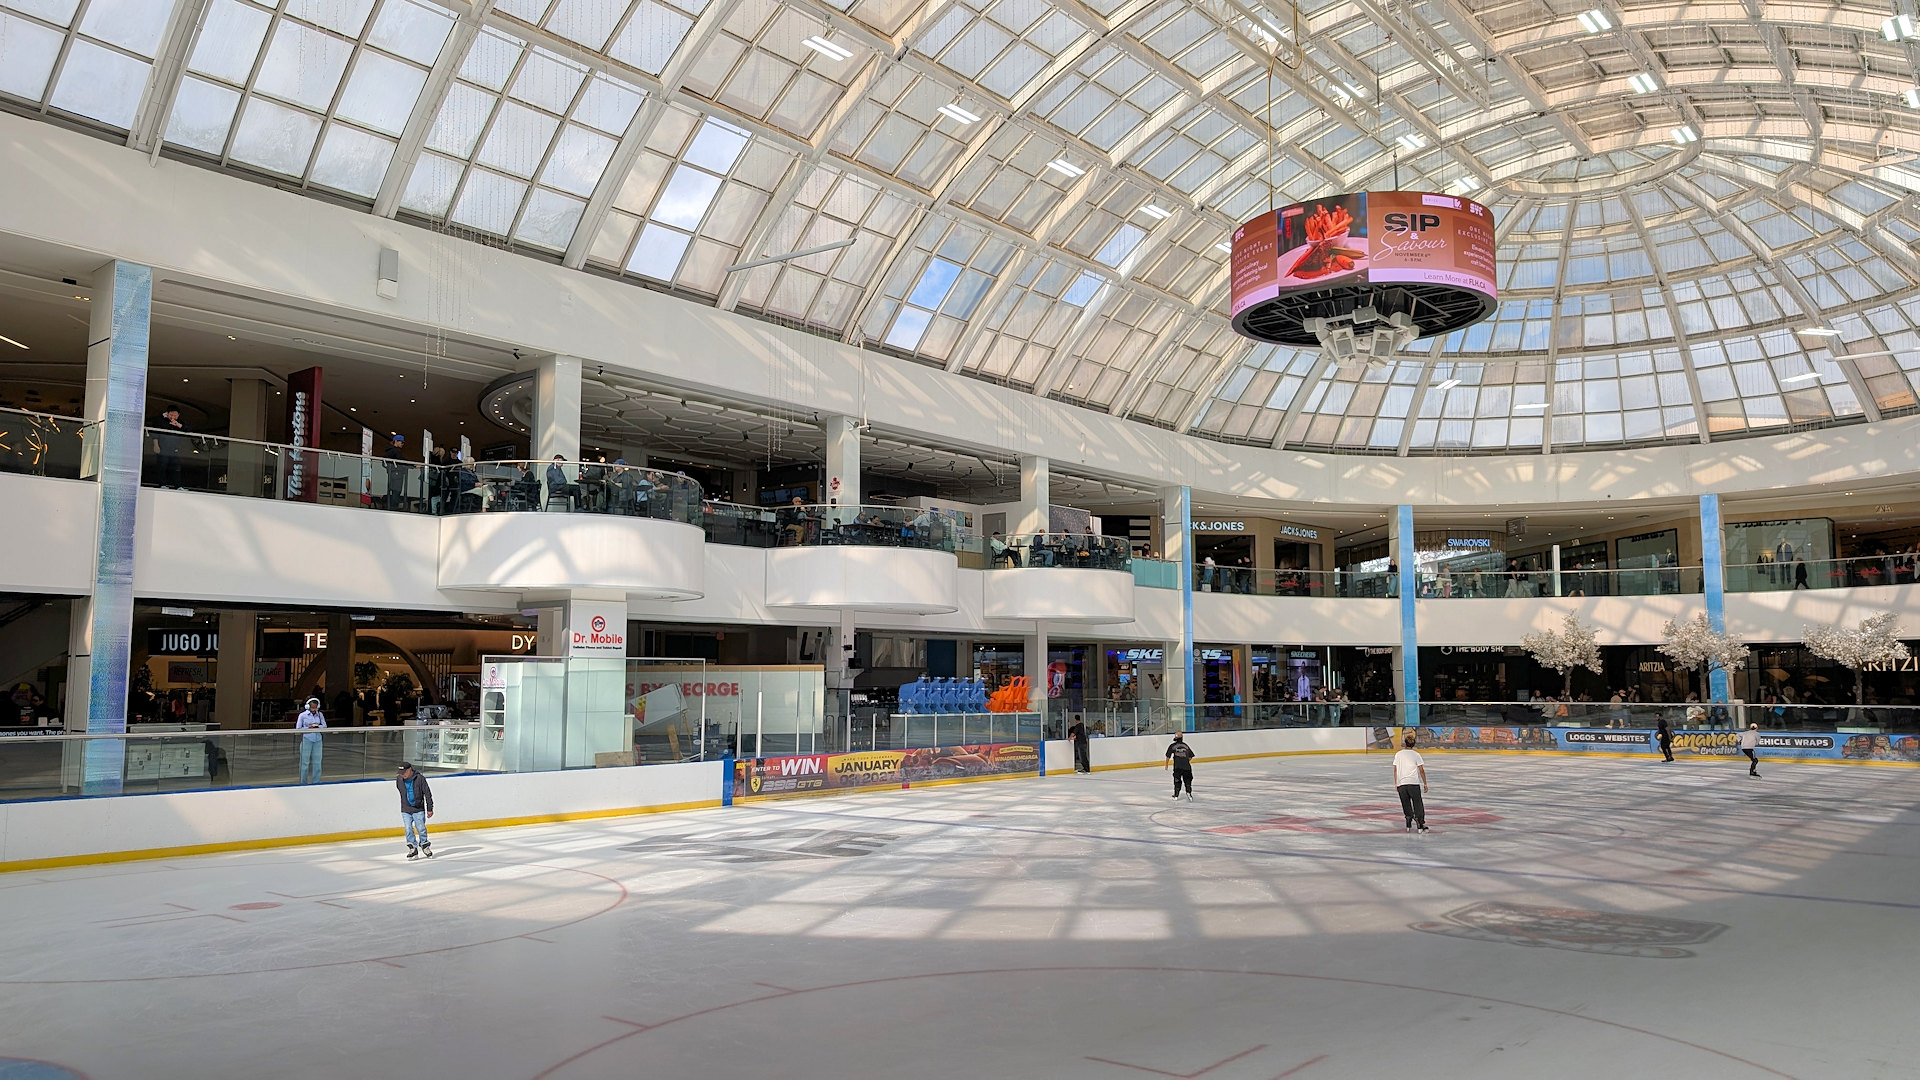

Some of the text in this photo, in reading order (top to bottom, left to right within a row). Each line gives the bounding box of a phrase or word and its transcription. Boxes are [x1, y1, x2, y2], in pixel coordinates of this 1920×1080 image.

[1384, 213, 1440, 232] SIP
[1373, 226, 1447, 262] Savour
[1280, 526, 1318, 539] JACK&JONES
[1448, 538, 1490, 546] SWAROVSKI
[161, 634, 200, 651] JUGO
[574, 632, 622, 644] Dr. Mobile
[1639, 662, 1666, 672] ARITZIA
[682, 682, 739, 696] EORGE
[1674, 732, 1737, 752] ananas
[834, 758, 900, 774] JANUARY
